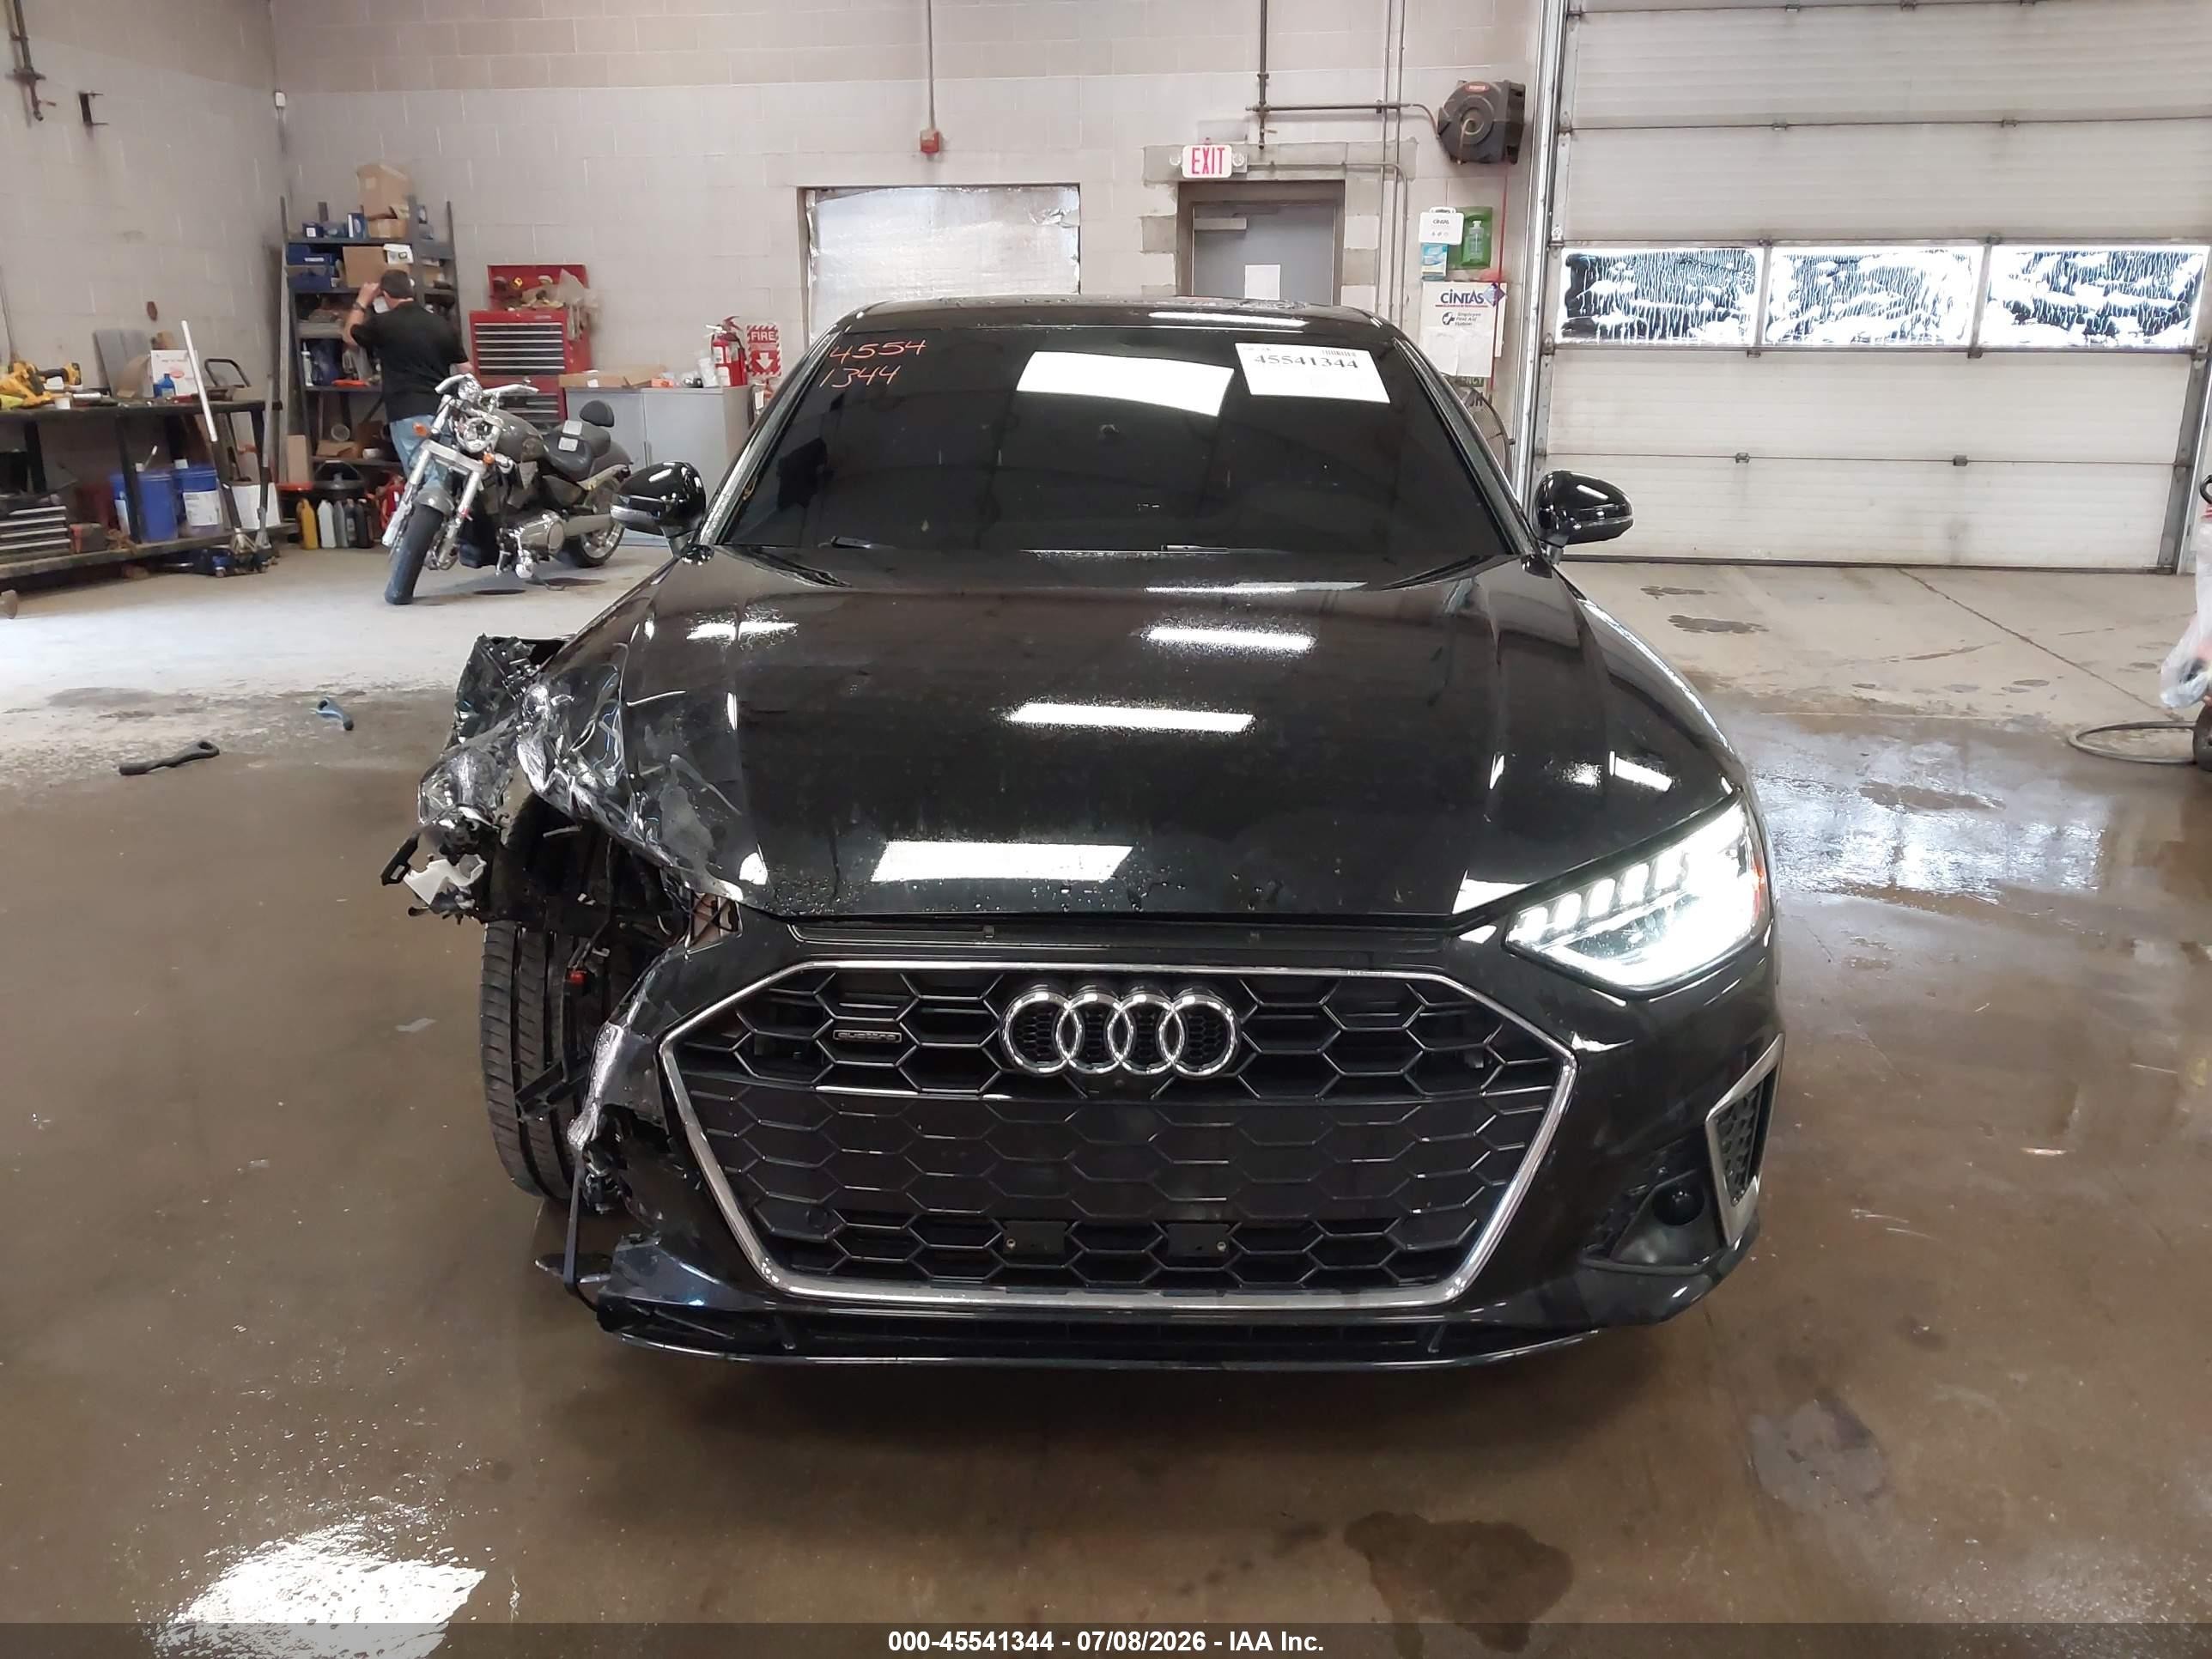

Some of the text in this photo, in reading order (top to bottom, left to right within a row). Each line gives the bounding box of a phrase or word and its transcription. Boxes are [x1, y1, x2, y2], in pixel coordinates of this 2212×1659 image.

[1192, 147, 1225, 174] EXIT
[750, 331, 775, 341] FIRE
[829, 339, 927, 364] 4554
[1254, 355, 1358, 368] 45541344
[818, 364, 902, 388] 1344
